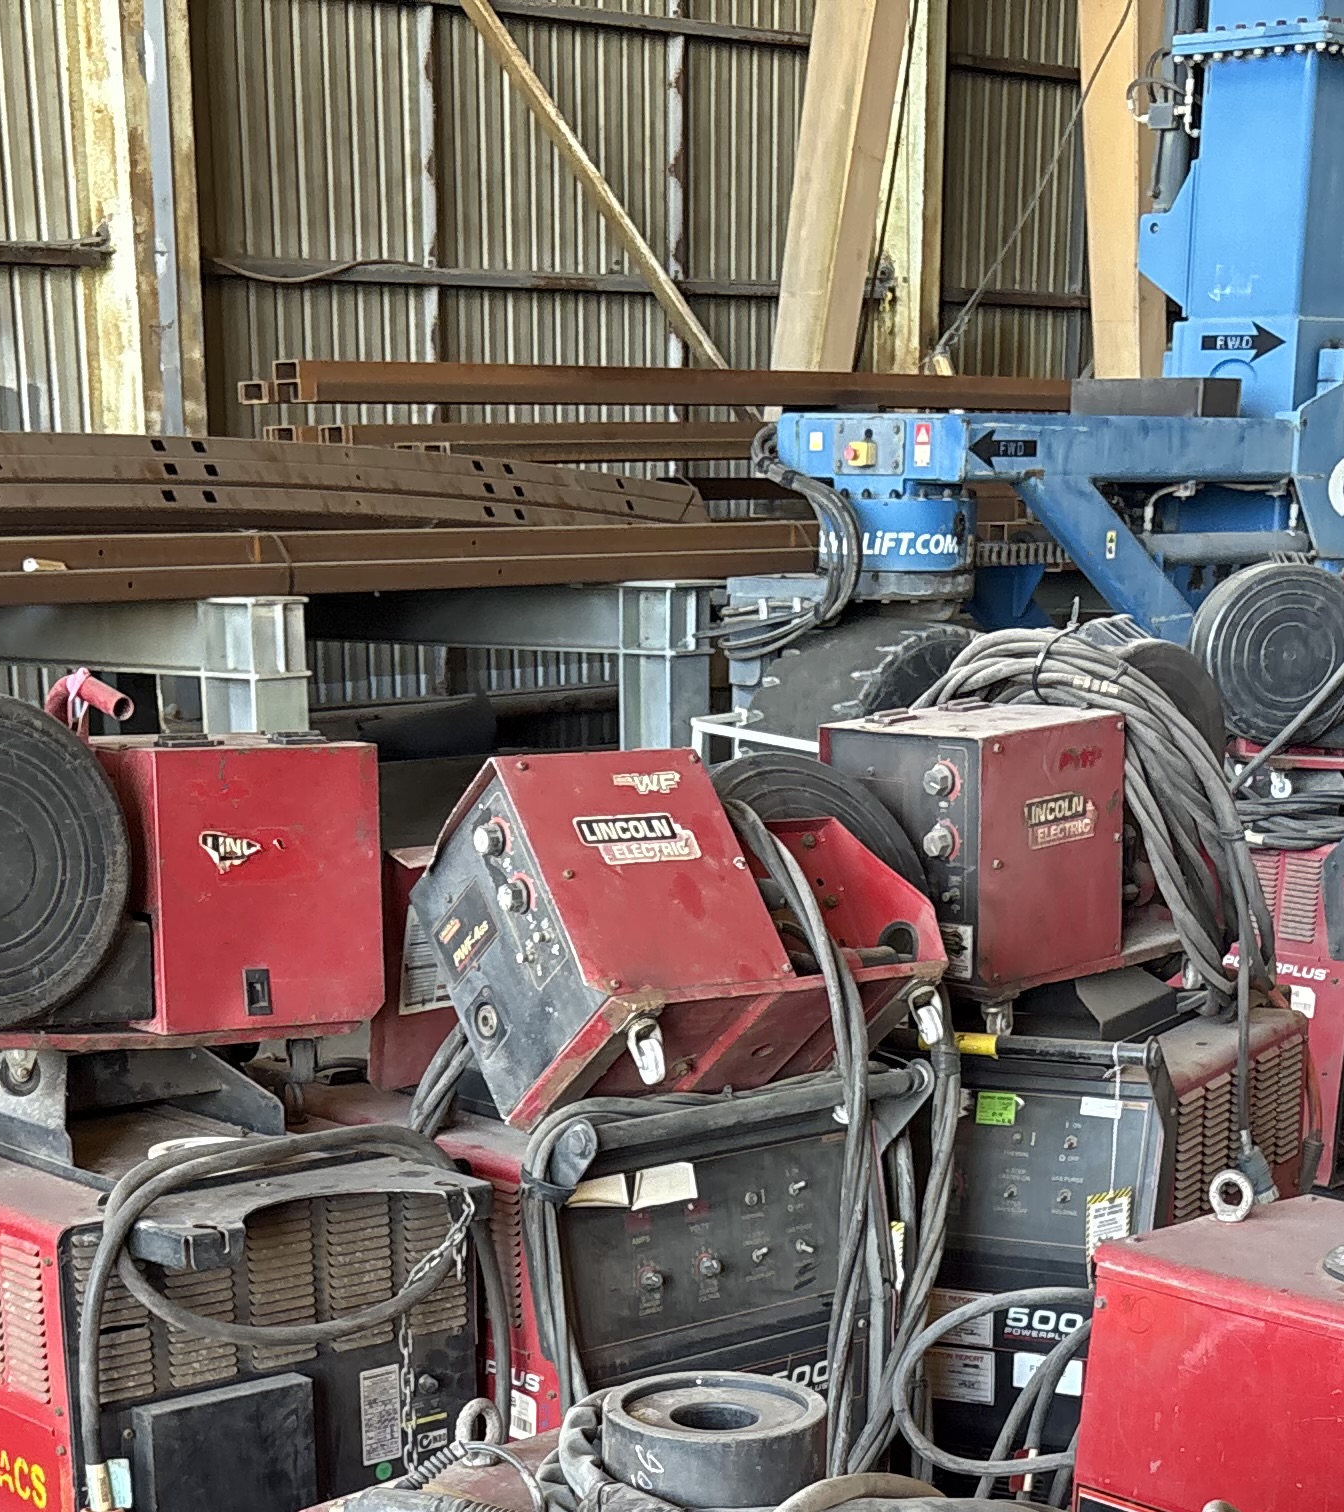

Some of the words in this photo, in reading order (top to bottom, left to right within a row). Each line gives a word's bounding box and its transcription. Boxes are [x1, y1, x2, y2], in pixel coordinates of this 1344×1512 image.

[999, 441, 1024, 456] FWD
[581, 818, 673, 842] LINCOLN
[612, 841, 691, 860] ELECTRIC
[1006, 1306, 1084, 1334] 500
[1004, 1326, 1069, 1341] POWERPL
